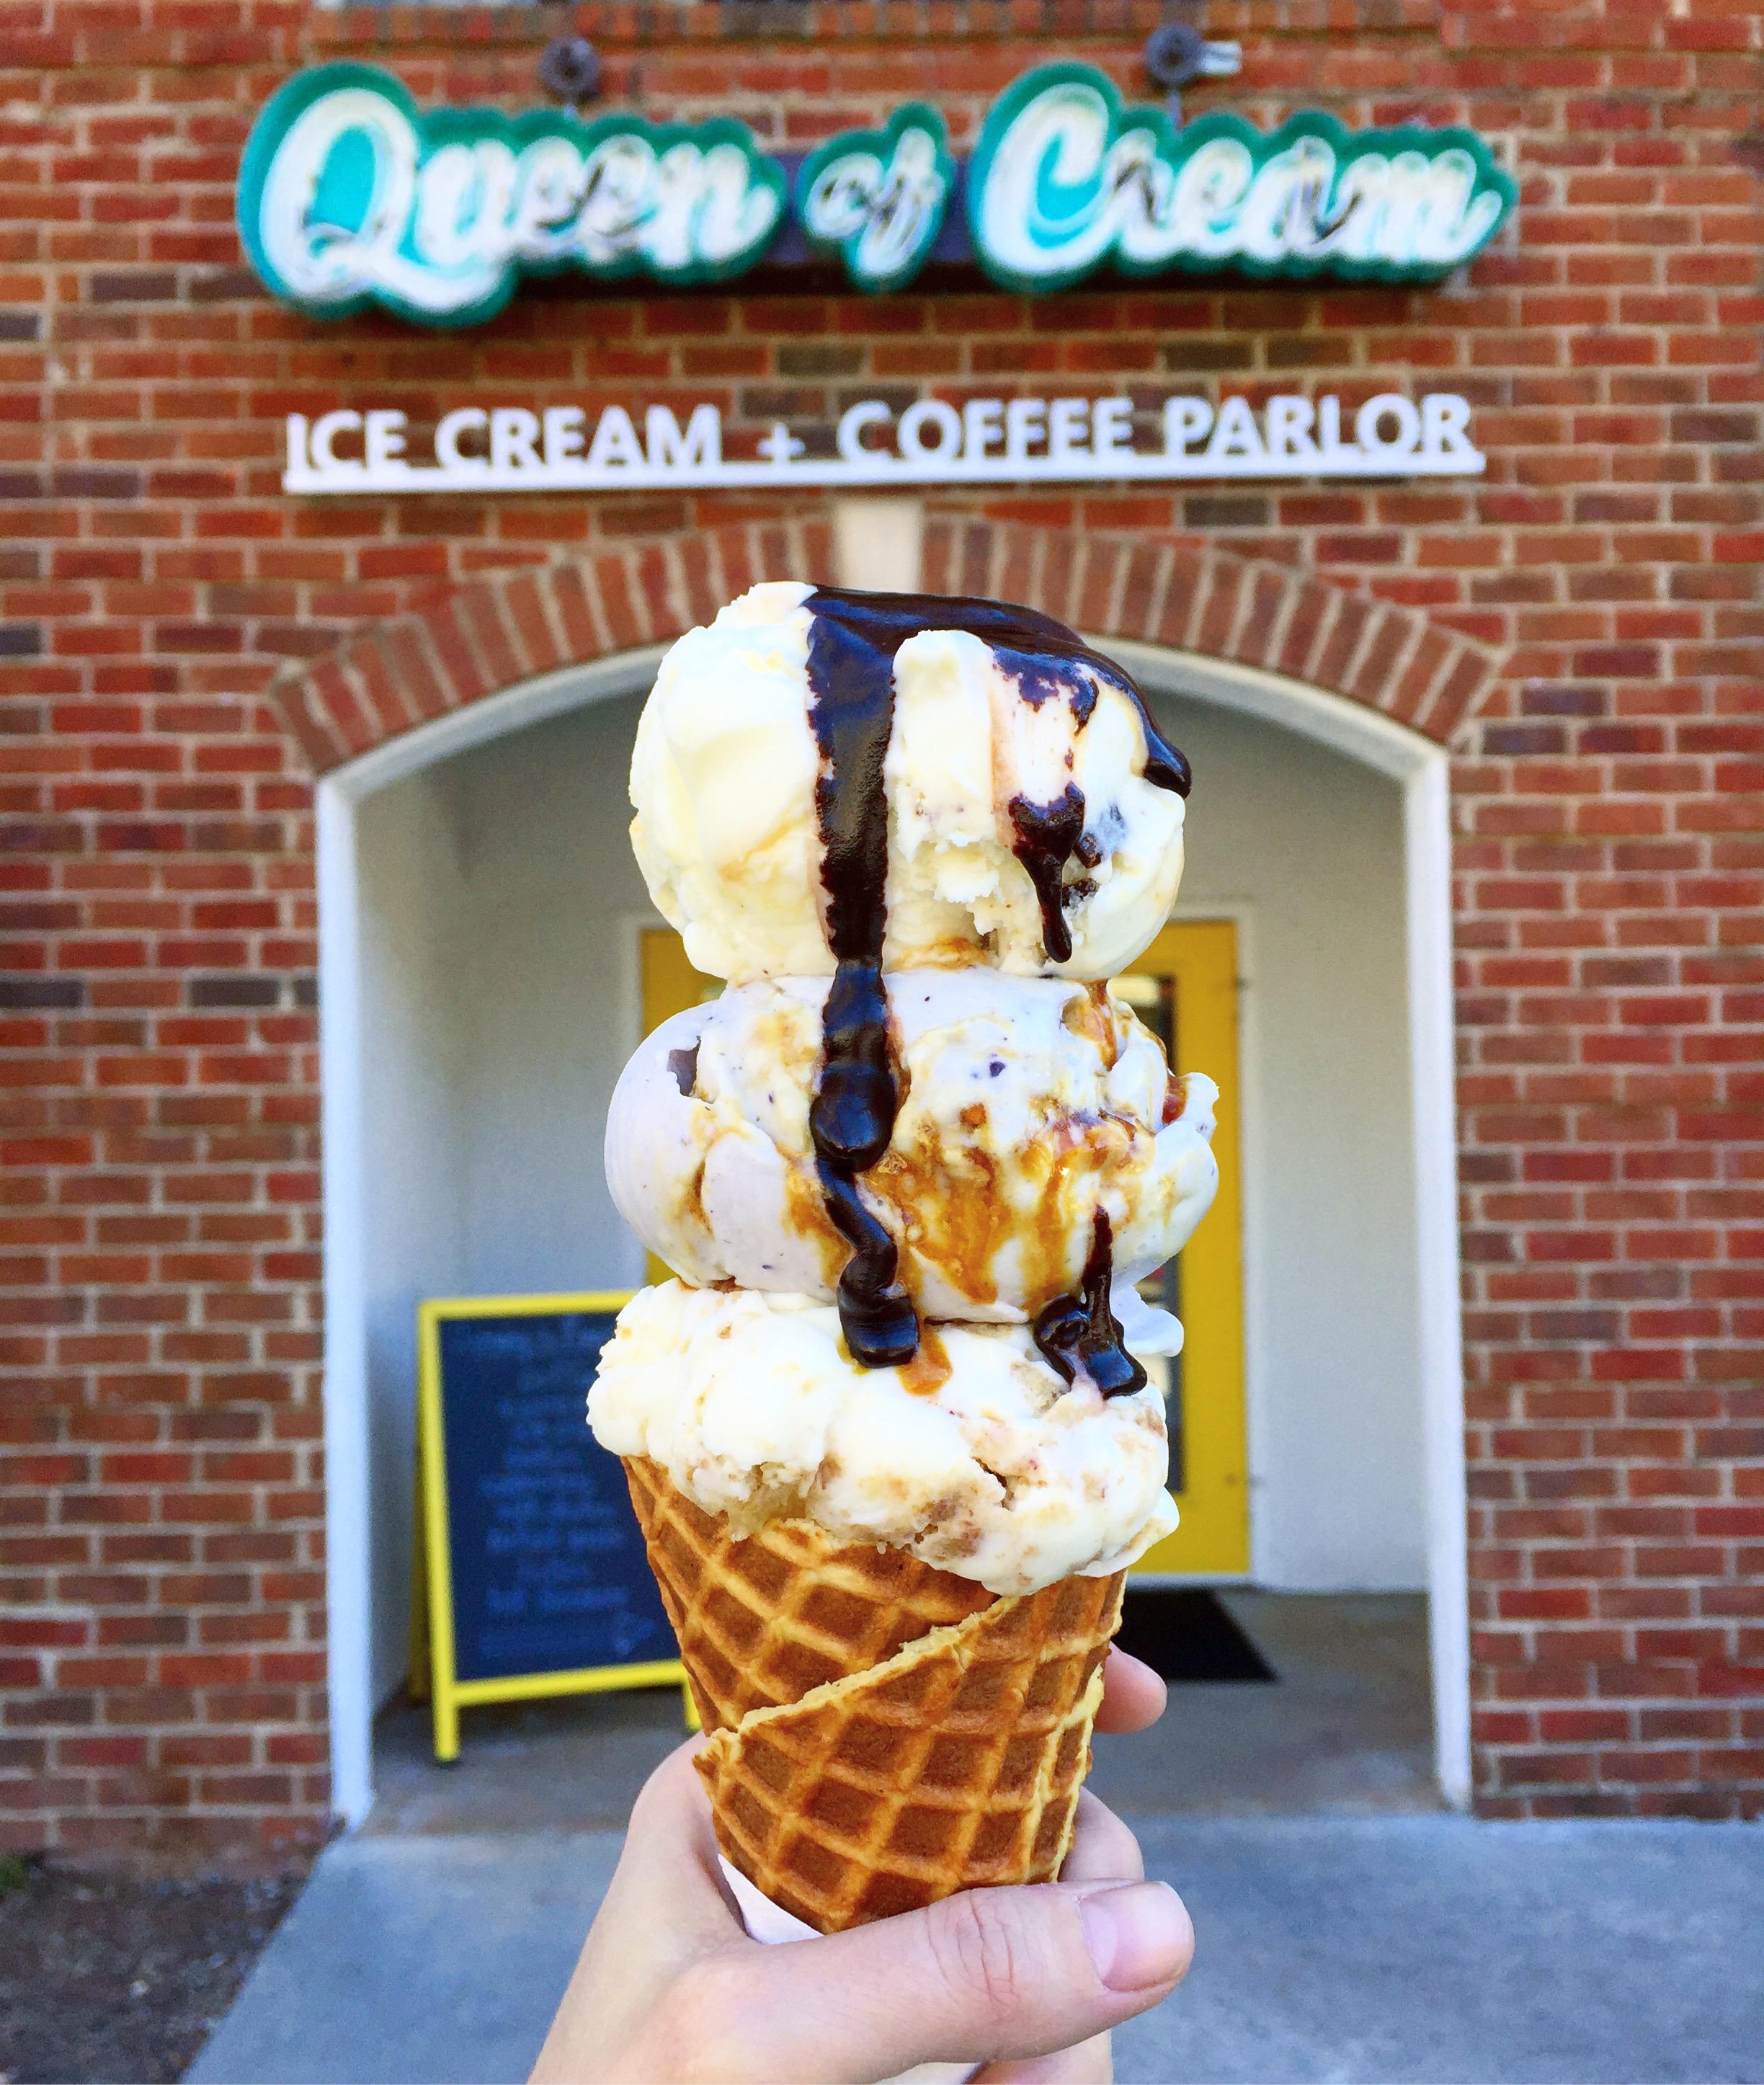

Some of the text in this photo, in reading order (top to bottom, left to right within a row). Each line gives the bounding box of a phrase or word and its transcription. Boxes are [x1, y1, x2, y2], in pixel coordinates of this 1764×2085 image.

[258, 82, 1503, 313] Queen of Cream
[288, 409, 408, 470] ICE
[435, 404, 722, 468] CREAM
[837, 396, 1134, 463] COFFEE
[1164, 394, 1479, 458] PARLOR
